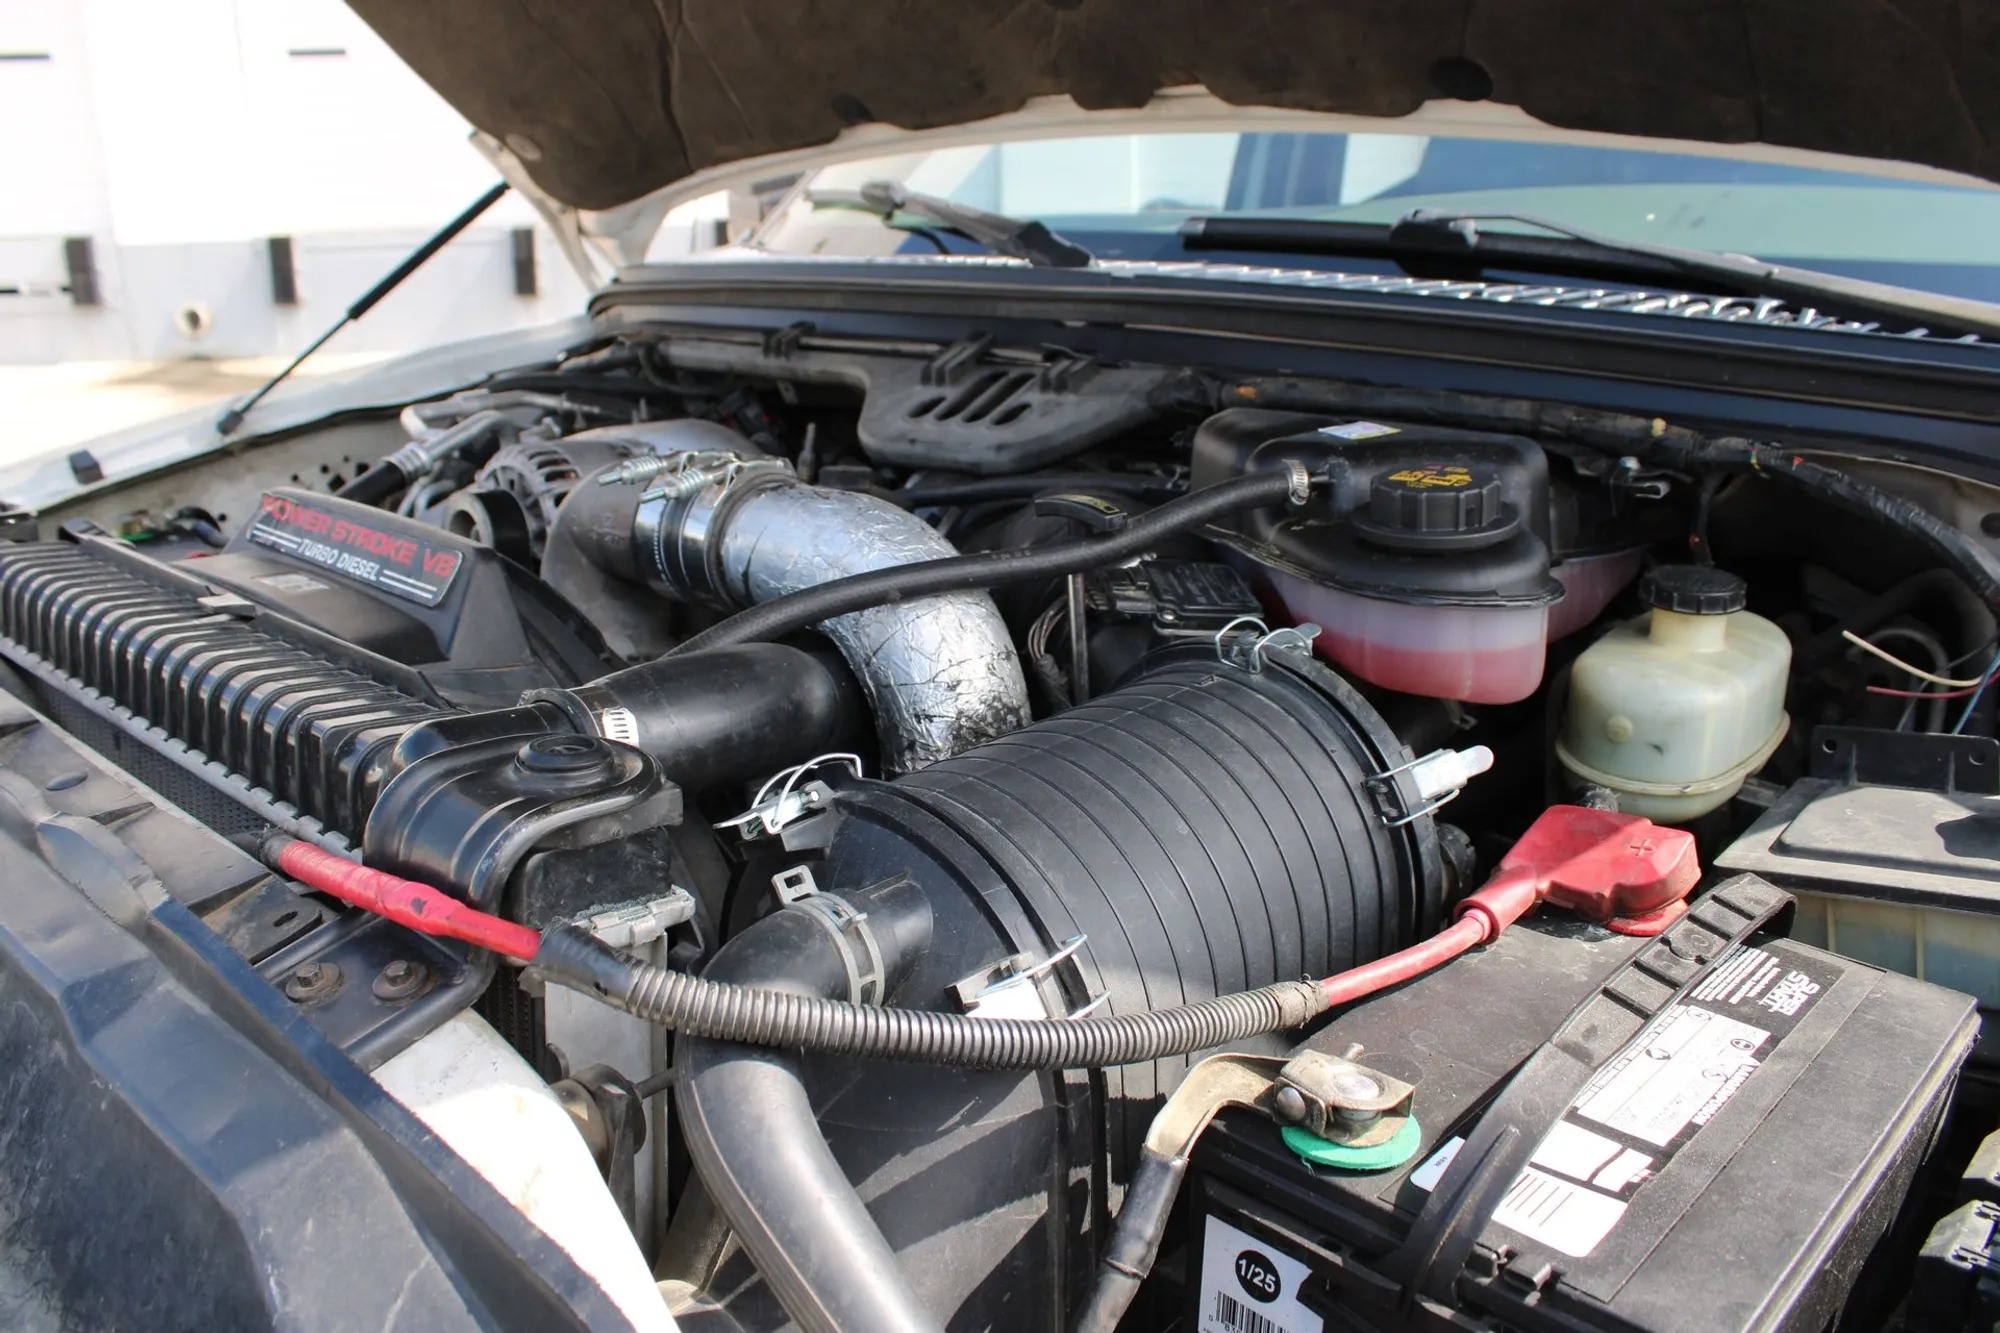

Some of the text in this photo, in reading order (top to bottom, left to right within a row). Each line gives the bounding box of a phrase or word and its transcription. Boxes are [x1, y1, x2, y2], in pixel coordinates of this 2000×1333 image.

[260, 495, 457, 578] POWER STROKE V8
[298, 538, 339, 562] TURBO
[337, 553, 380, 582] DIESEL
[1761, 970, 1809, 1012] START
[1777, 982, 1820, 1016] SUPER
[1238, 1258, 1276, 1293] 1/25
